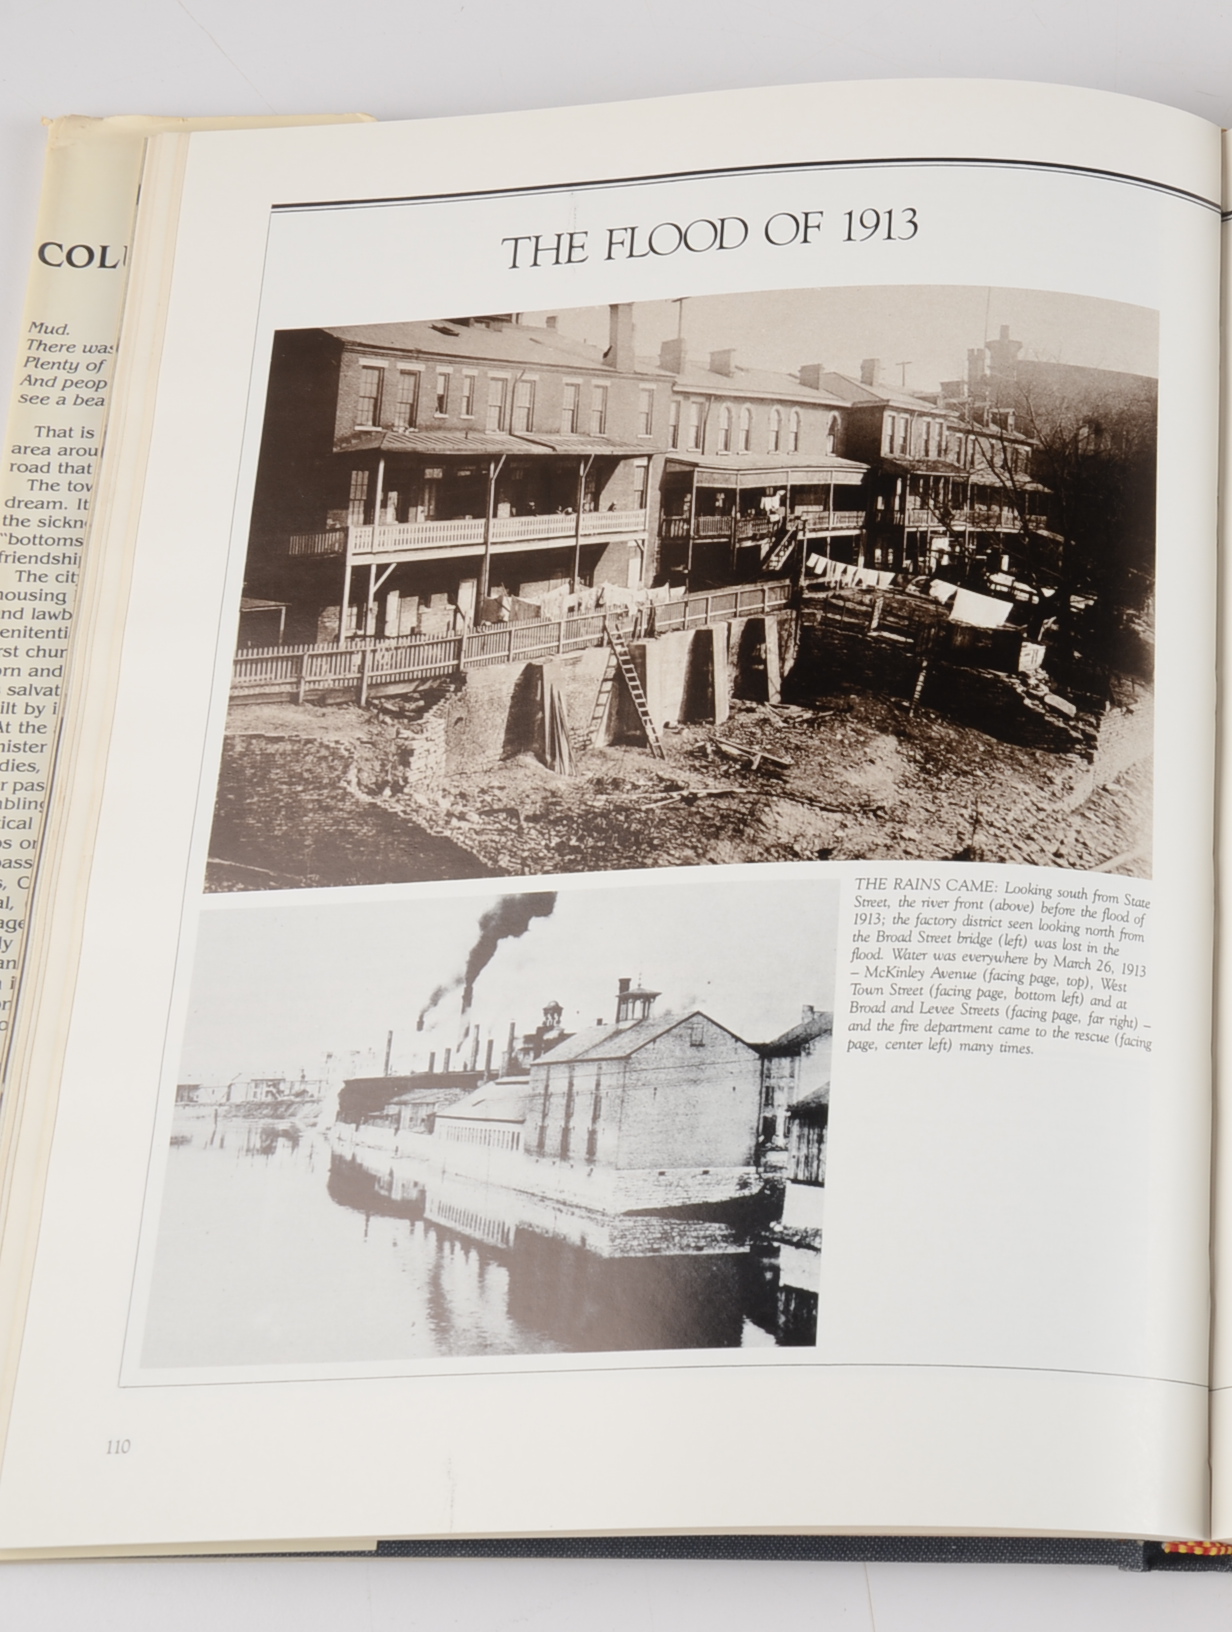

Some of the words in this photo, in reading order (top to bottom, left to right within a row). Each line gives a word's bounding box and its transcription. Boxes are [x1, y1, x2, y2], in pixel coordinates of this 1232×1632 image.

[501, 230, 589, 269] THE
[604, 216, 749, 261] FLOOD
[764, 210, 824, 246] OF
[842, 207, 919, 242] 1913
[38, 242, 127, 268] COL
[28, 322, 70, 335] Mud.
[27, 339, 76, 353] There
[24, 356, 79, 373] Plenty
[86, 359, 107, 374] of
[20, 374, 57, 388] And
[61, 379, 107, 392] peop
[18, 394, 50, 405] see
[56, 395, 66, 405] a
[73, 395, 105, 406] bea
[34, 426, 73, 438] That
[80, 426, 95, 439] is
[11, 445, 51, 456] area
[58, 446, 98, 457] arou
[10, 462, 51, 474] road
[58, 462, 92, 474] that
[27, 479, 60, 492] The
[5, 497, 68, 510] dream.
[77, 498, 89, 510] It
[3, 515, 31, 527] the
[37, 515, 87, 529] sickn
[15, 570, 48, 583] The
[32, 608, 72, 621] lawb
[26, 646, 67, 658] chur
[28, 665, 62, 678] and
[7, 684, 61, 696] salvat
[24, 703, 45, 718] by
[19, 722, 47, 734] the
[0, 759, 40, 773] dies,
[13, 781, 45, 794] pas
[0, 816, 33, 830] ical
[0, 858, 33, 869] ass
[855, 877, 888, 890] THE
[893, 877, 941, 891] RAINS
[946, 878, 999, 893] CAME:
[1005, 881, 1053, 900] Looking
[1057, 887, 1088, 900] south
[1092, 889, 1119, 904] from
[1124, 894, 1151, 909] State
[854, 895, 891, 910] Street,
[898, 897, 916, 909] the
[921, 896, 950, 909] river
[954, 898, 984, 912] front
[989, 899, 1035, 915] (above)
[1041, 901, 1075, 918] before
[1081, 905, 1097, 919] the
[1101, 907, 1129, 923] flood
[1134, 913, 1146, 927] of
[854, 913, 886, 927] 1913;
[892, 913, 910, 926] the
[914, 914, 957, 928] factory
[962, 915, 1002, 929] district
[1007, 918, 1033, 931] seen
[1038, 918, 1081, 937] looking
[1085, 924, 1115, 937] north
[1119, 926, 1144, 943] from
[852, 931, 870, 943] the
[876, 931, 912, 943] Broad
[918, 931, 951, 944] Street
[957, 932, 993, 948] bridge
[998, 933, 1028, 949] (left)
[1034, 939, 1057, 950] was
[1062, 938, 1082, 952] lost
[1087, 941, 1098, 953] in
[1103, 942, 1120, 957] the
[850, 948, 884, 962] flood.
[892, 948, 928, 962] Water
[933, 951, 956, 962] was
[962, 952, 1028, 965] everywhere
[1033, 952, 1048, 969] by
[1053, 955, 1091, 971] March
[1096, 960, 1115, 975] 26,
[1122, 962, 1146, 977] 1913
[865, 966, 925, 981] McKinley
[930, 967, 977, 980] Avenue
[982, 967, 1025, 985] (facing
[1029, 972, 1059, 987] page,
[1066, 972, 1093, 990] top),
[1101, 977, 1127, 993] West
[851, 984, 884, 996] Town
[889, 984, 923, 996] Street
[929, 984, 971, 999] (facing
[976, 989, 1007, 1001] page,
[1014, 988, 1056, 1001] bottom
[1061, 990, 1084, 1005] left)
[1090, 994, 1112, 1008] and
[1116, 998, 1127, 1010] at
[850, 1002, 886, 1014] Broad
[891, 1002, 914, 1014] and
[919, 1002, 954, 1015] Levee
[960, 1003, 999, 1017] Streets
[1006, 1004, 1047, 1022] (facing
[1052, 1010, 1081, 1025] page,
[1087, 1012, 1104, 1027] far
[1109, 1014, 1138, 1030] right)
[848, 1019, 871, 1031] and
[877, 1019, 895, 1031] the
[899, 1019, 919, 1034] fire
[924, 1020, 993, 1035] department
[998, 1025, 1030, 1037] came
[1036, 1026, 1047, 1038] to
[1053, 1025, 1070, 1039] the
[1075, 1030, 1109, 1044] rescue
[1114, 1032, 1152, 1052] (facing
[847, 1040, 878, 1053] page,
[885, 1038, 923, 1051] center
[928, 1038, 952, 1053] left)
[959, 1042, 993, 1055] many
[999, 1042, 1034, 1055] times.
[106, 1438, 131, 1454] 110
